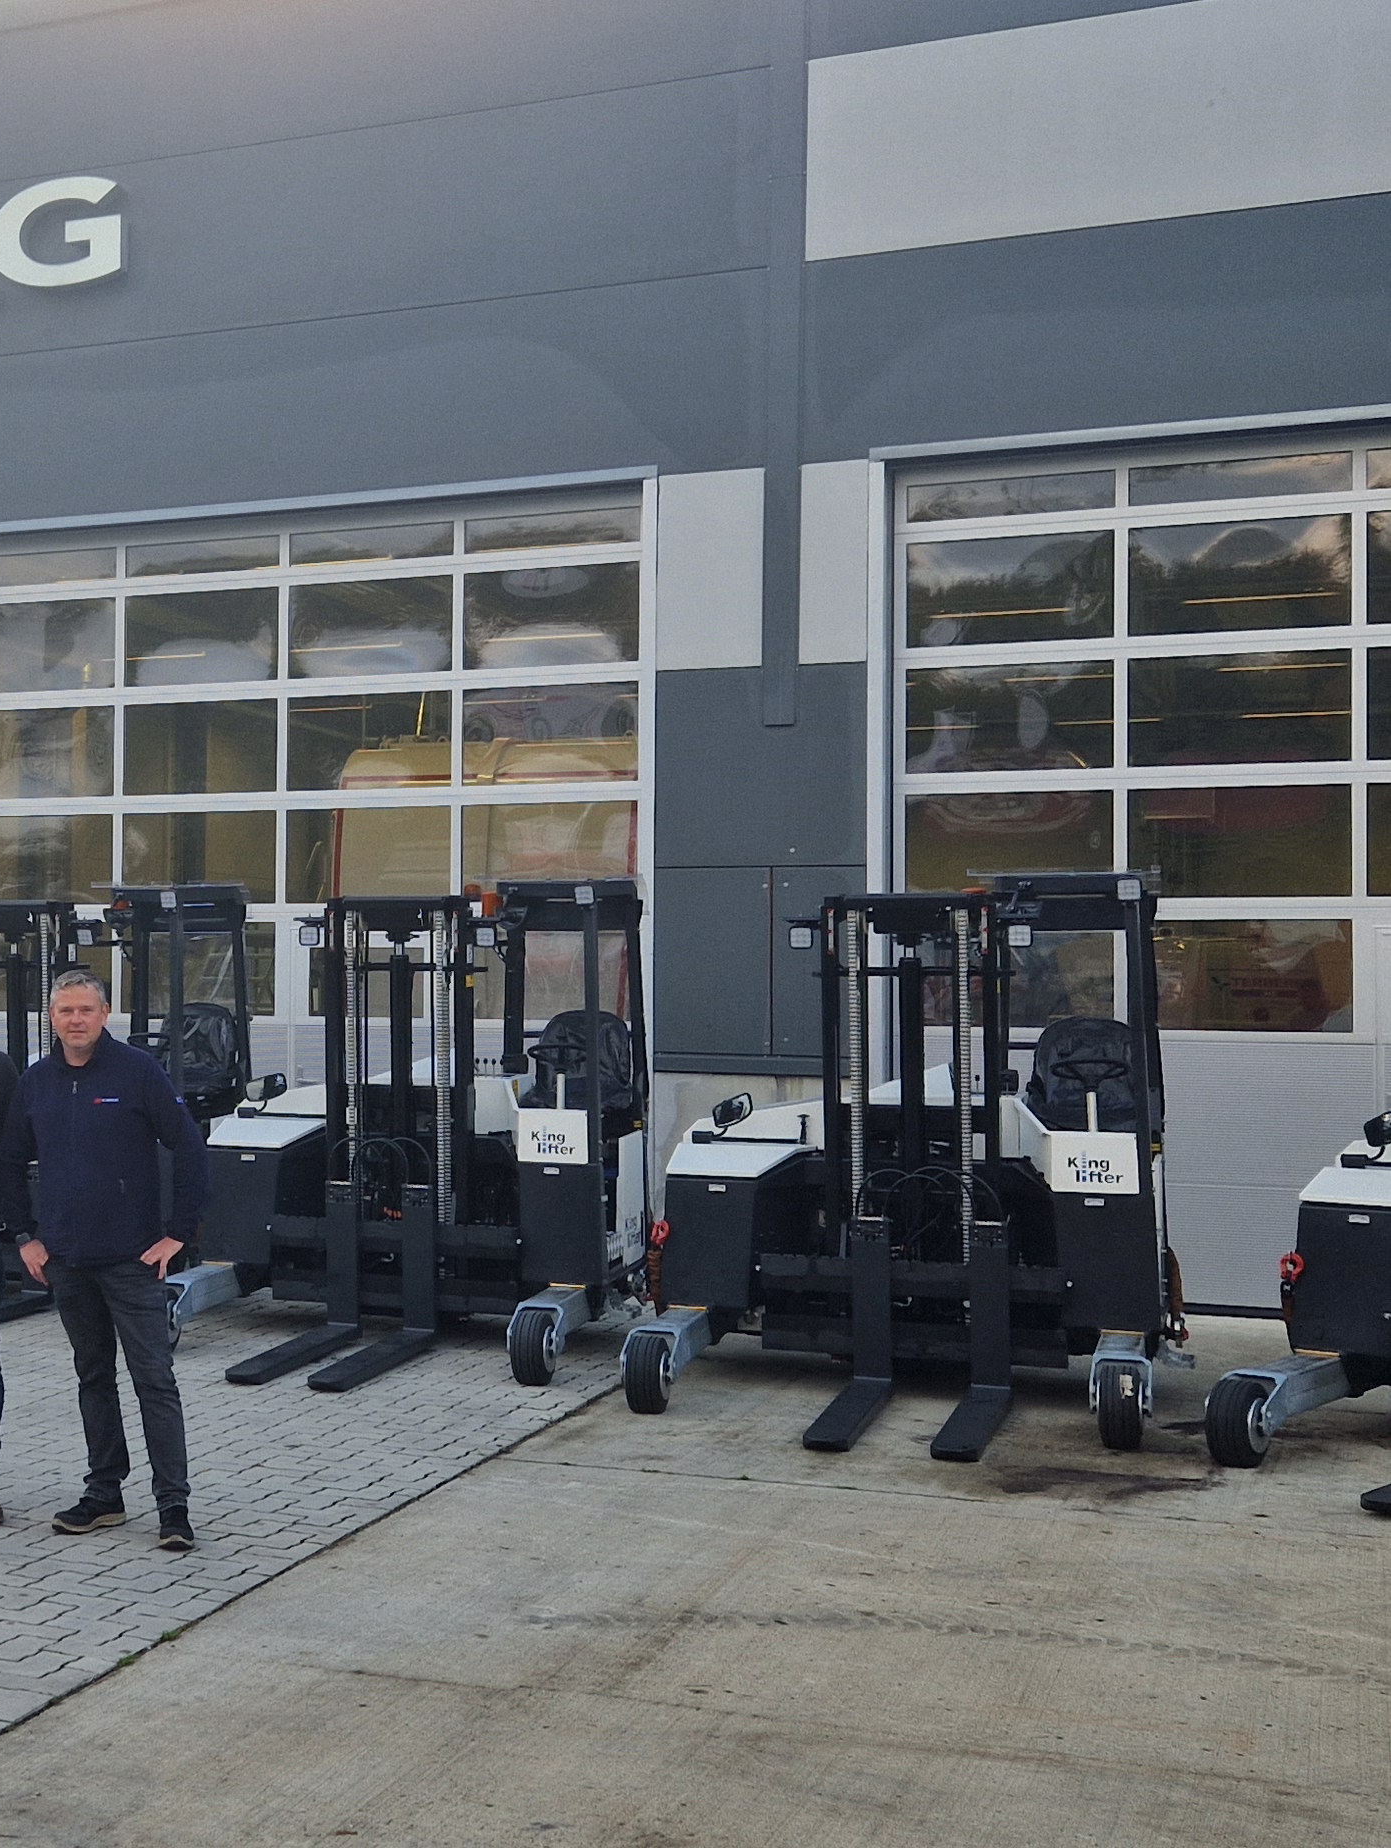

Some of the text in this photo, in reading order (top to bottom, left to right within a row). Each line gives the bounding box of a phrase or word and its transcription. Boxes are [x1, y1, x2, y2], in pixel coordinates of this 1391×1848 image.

[531, 1127, 566, 1145] King
[537, 1143, 576, 1155] lifter
[1067, 1152, 1110, 1172] King
[1075, 1169, 1124, 1184] lifter
